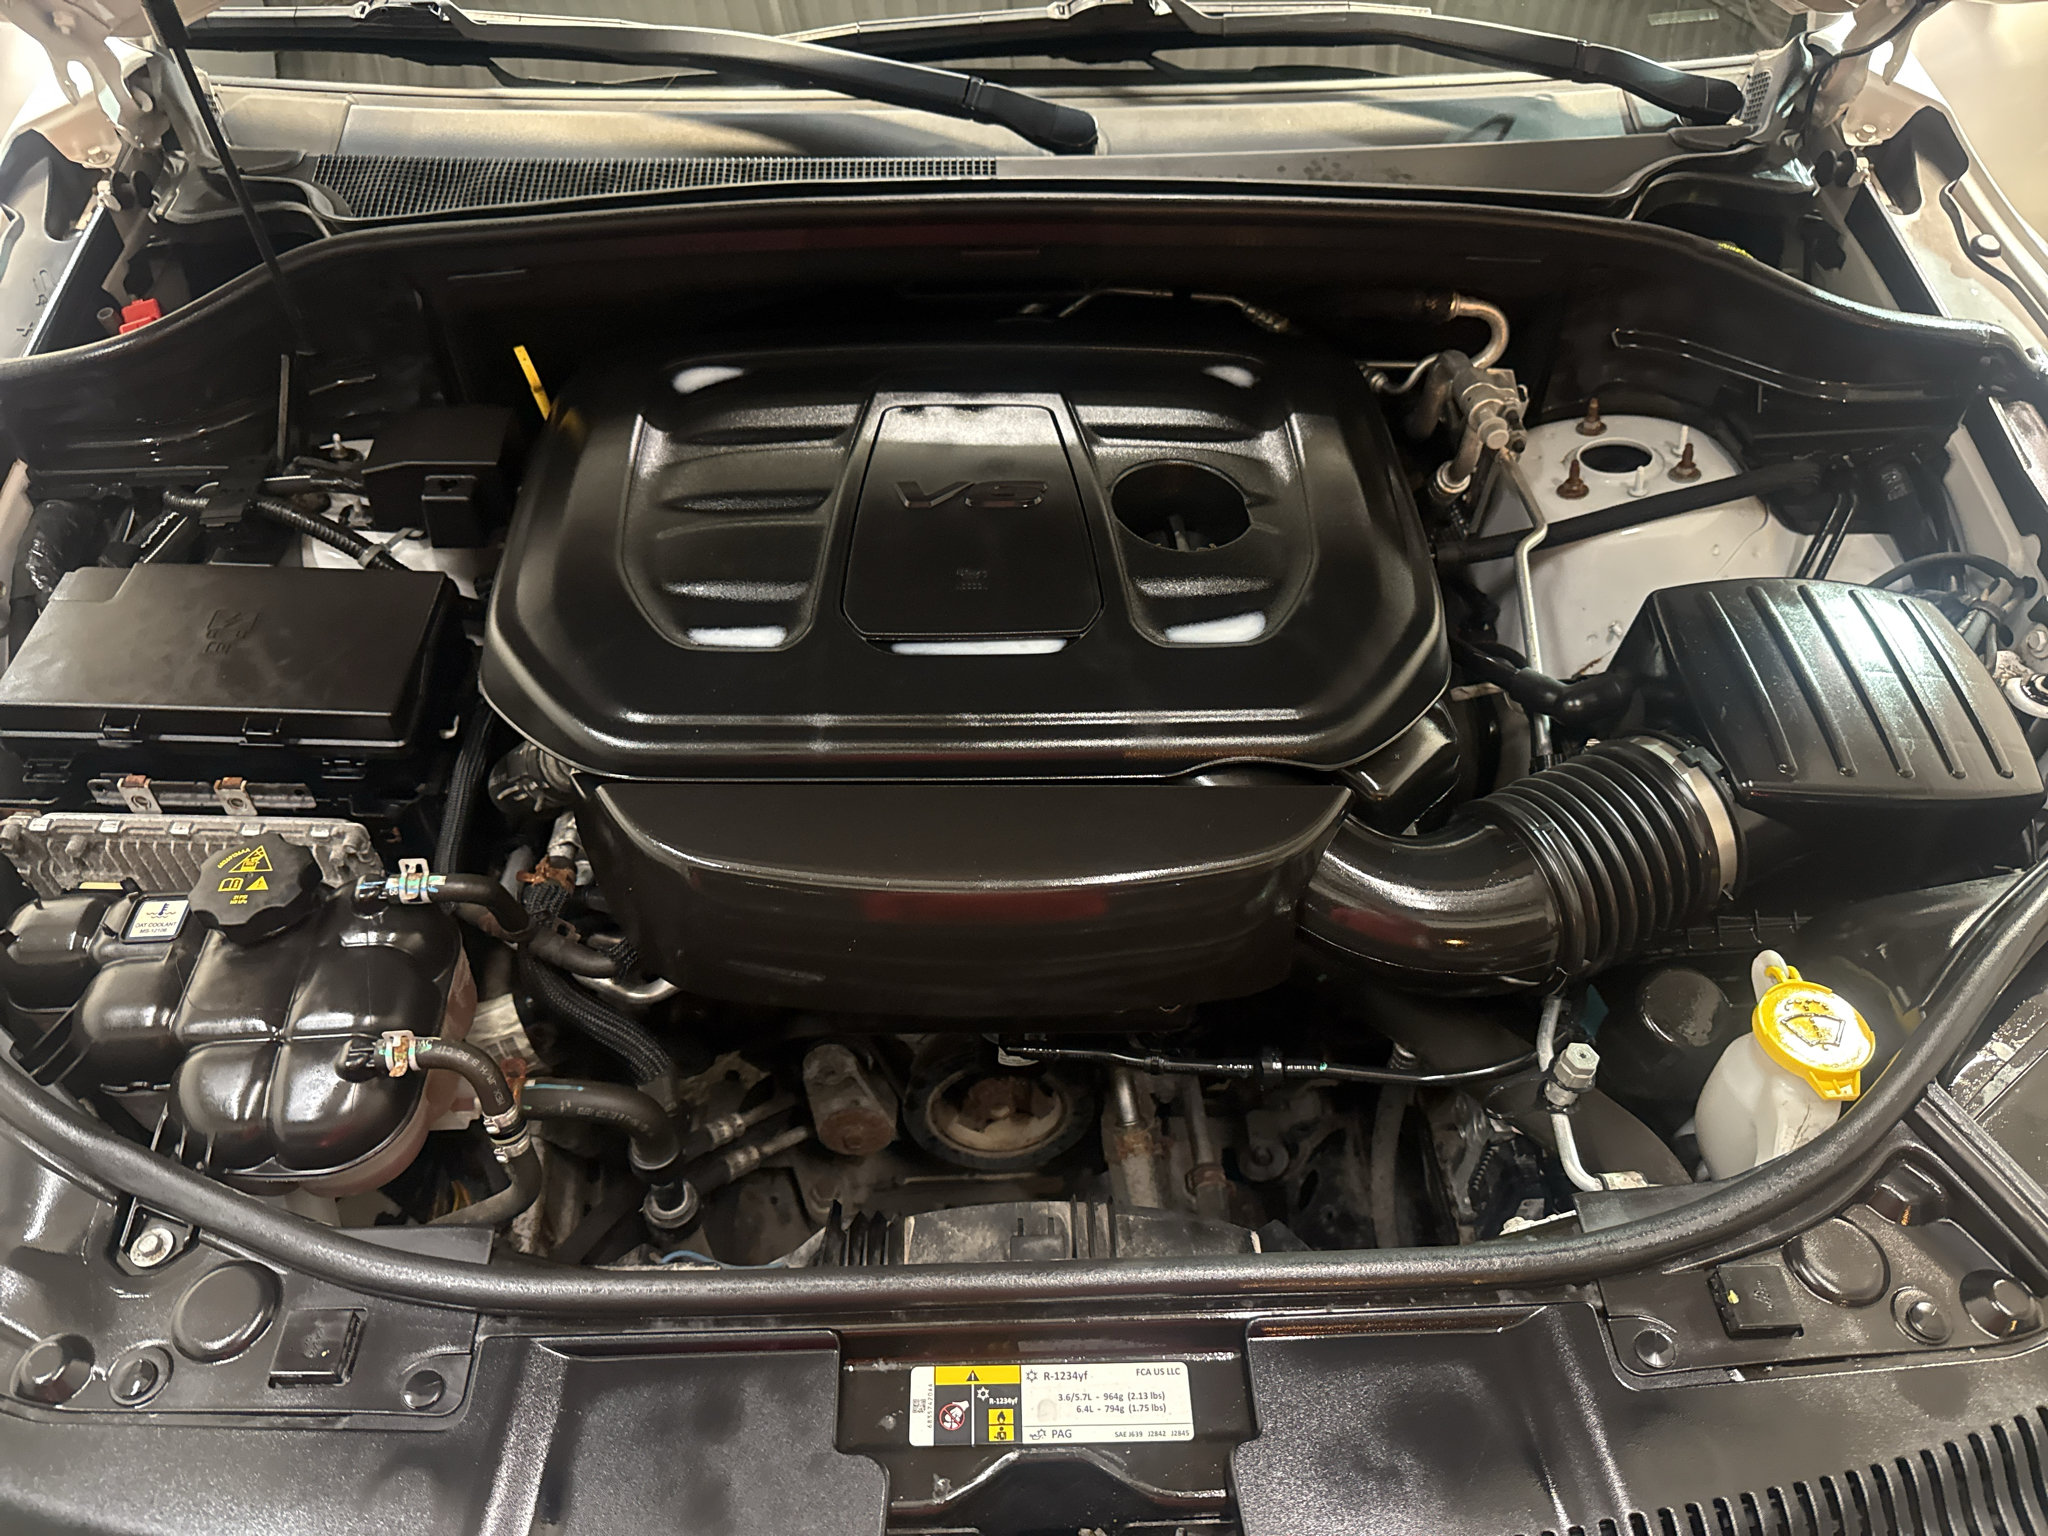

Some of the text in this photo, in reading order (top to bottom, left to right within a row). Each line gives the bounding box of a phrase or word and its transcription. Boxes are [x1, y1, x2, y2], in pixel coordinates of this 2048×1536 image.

[893, 480, 1048, 509] V6
[1043, 1370, 1088, 1383] R-1234yf
[1136, 1367, 1181, 1377] FCA US LLC
[988, 1396, 1018, 1406] R-1234yf
[1058, 1393, 1093, 1402] 3.6/5.7L
[1103, 1392, 1124, 1402] 964g
[1127, 1392, 1149, 1402] (2.13
[1150, 1391, 1166, 1401] lbs)
[1076, 1405, 1094, 1413] 6.4L
[1104, 1404, 1125, 1414] 794g
[1128, 1404, 1150, 1414] (1.75
[1151, 1403, 1167, 1413] lbs)
[1051, 1429, 1072, 1439] PAG
[1128, 1430, 1143, 1438] J639
[1171, 1429, 1190, 1437] J2845
